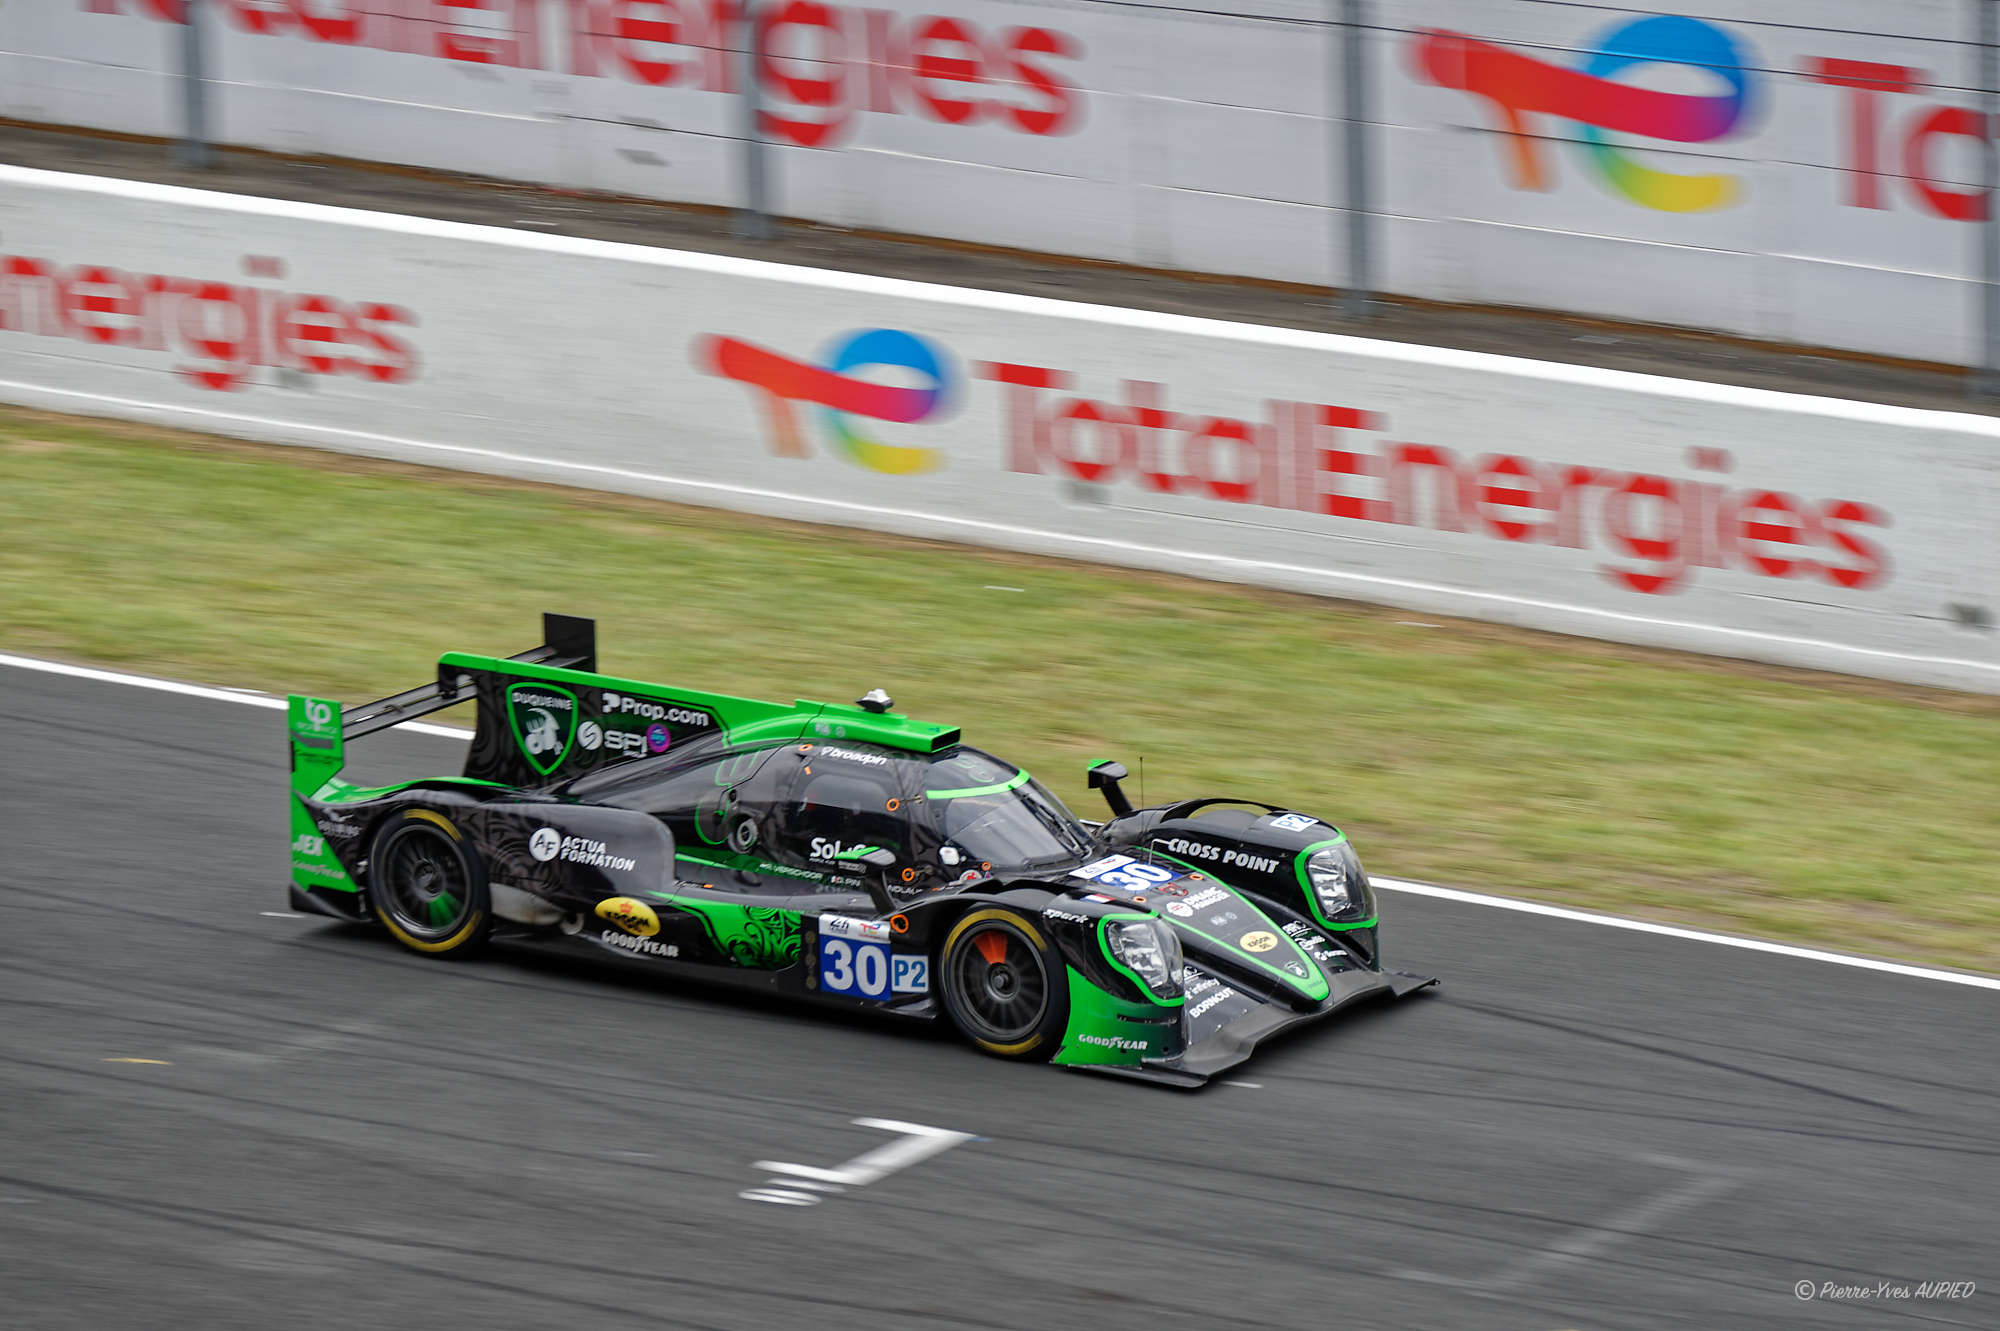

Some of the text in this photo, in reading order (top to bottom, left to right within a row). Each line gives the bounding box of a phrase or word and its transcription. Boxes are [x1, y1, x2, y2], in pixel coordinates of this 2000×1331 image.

[0, 255, 420, 392] nergies
[974, 360, 1892, 595] TotalEnergies
[512, 692, 572, 710] DUQUEINE
[621, 697, 709, 726] Prop.com
[829, 746, 887, 766] broadpin
[1277, 813, 1314, 829] P2
[559, 836, 606, 853] ACTUA
[1168, 838, 1280, 874] CROSS POINT
[560, 848, 636, 871] FORMATION
[1100, 862, 1173, 891] 30
[1042, 907, 1090, 924] spark
[601, 929, 680, 958] GOODYEAR
[823, 939, 888, 996] 30
[893, 959, 927, 989] P2
[1078, 1033, 1149, 1051] GOODYEAR
